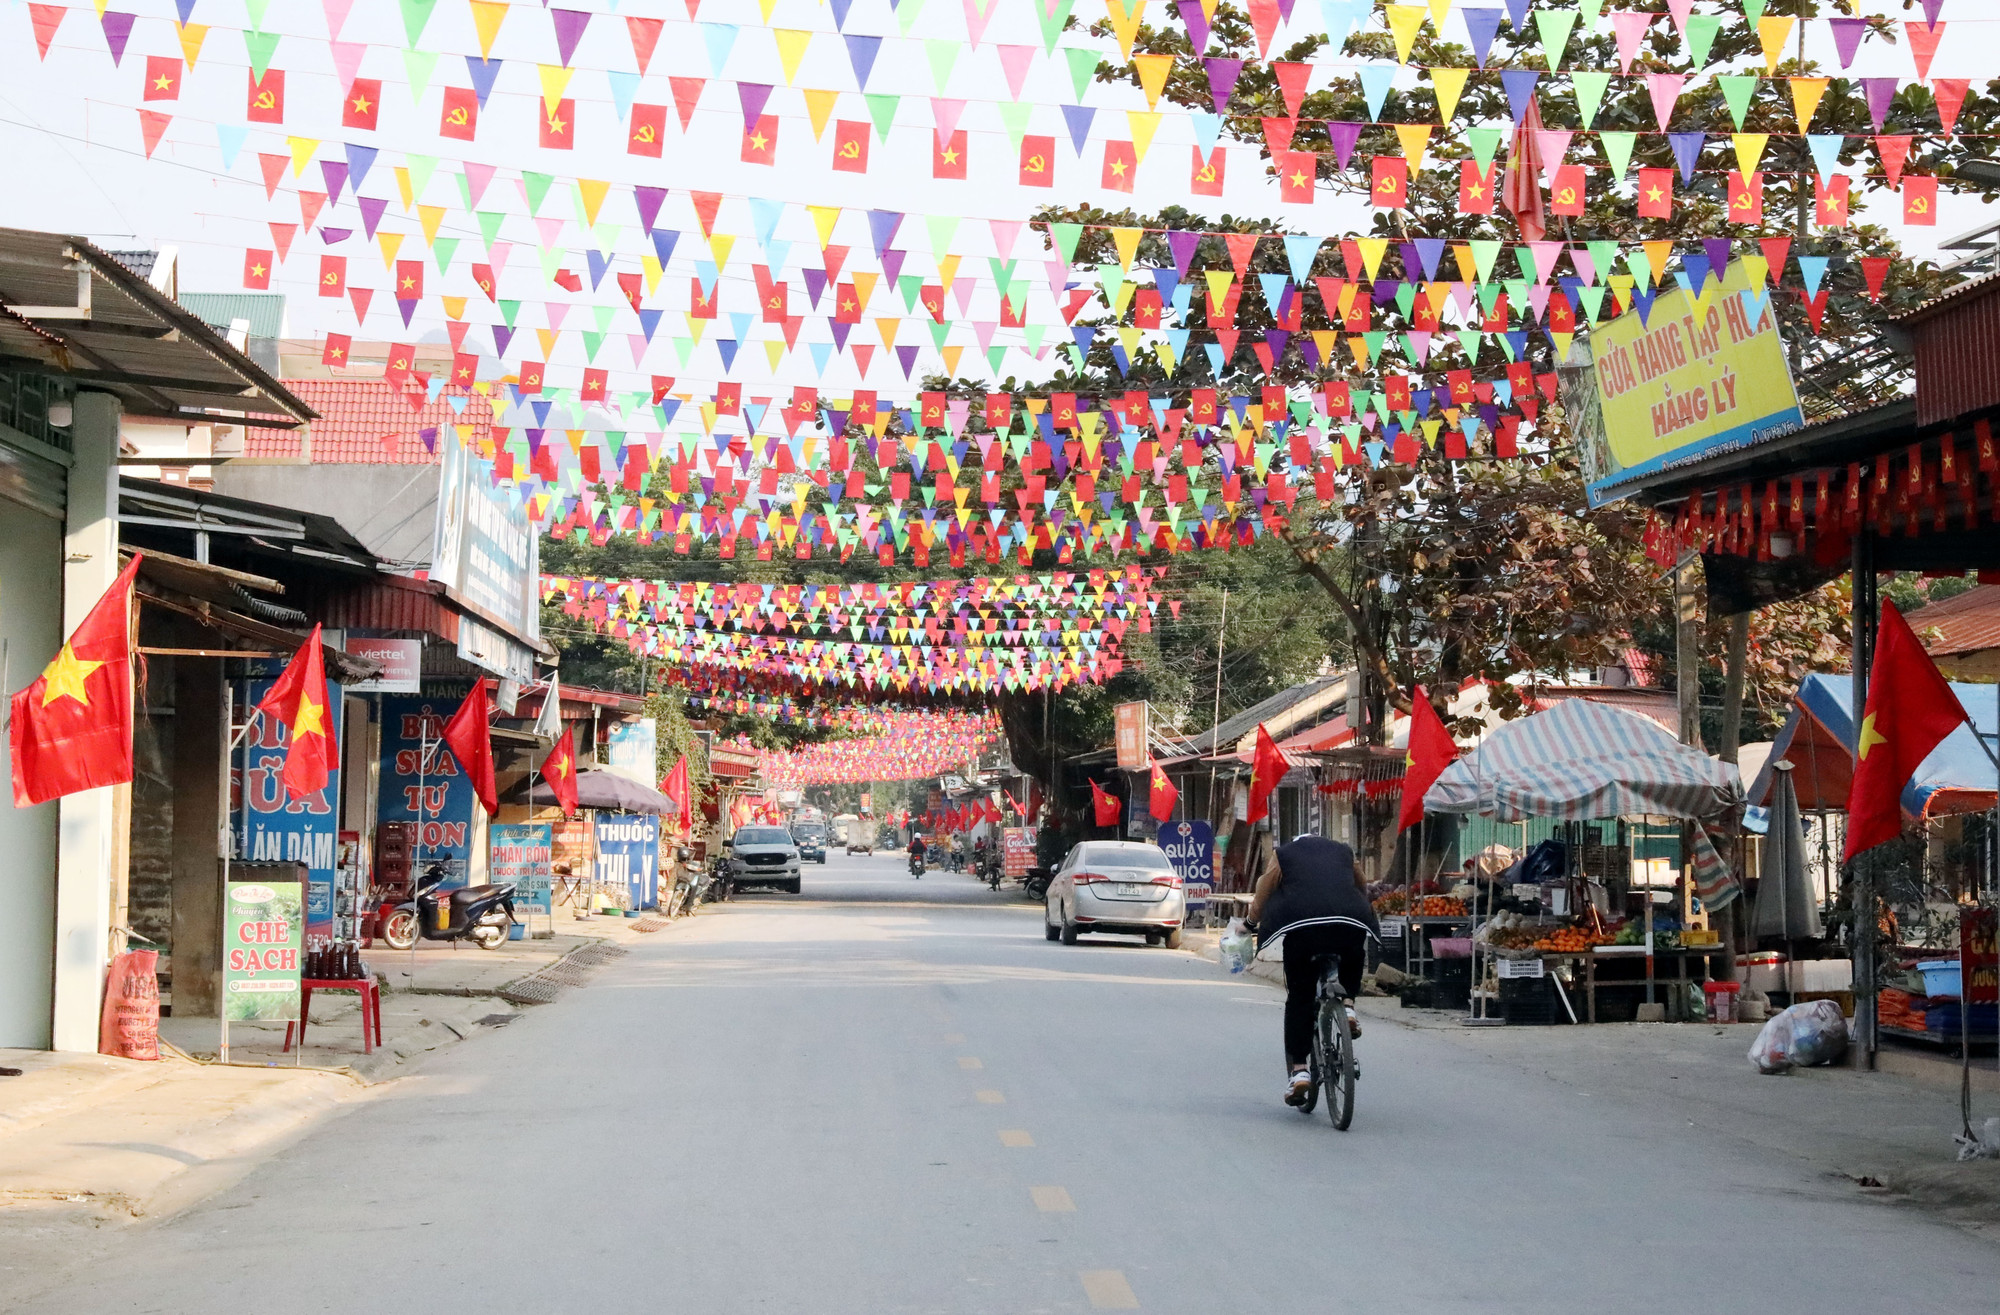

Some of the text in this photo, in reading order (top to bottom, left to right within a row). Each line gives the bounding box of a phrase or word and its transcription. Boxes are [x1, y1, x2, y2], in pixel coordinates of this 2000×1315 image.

[1598, 338, 1637, 400] CỬA
[1632, 322, 1688, 384] HÀNG
[1683, 304, 1721, 366] TẠP
[1651, 365, 1737, 438] HẰNG LÝ
[360, 648, 405, 659] viettel
[404, 781, 449, 818] TỰ
[253, 823, 281, 861] ĂN
[599, 818, 654, 842] THUỐC
[492, 843, 522, 864] PHÂN
[1165, 836, 1206, 859] QUẦY
[598, 845, 630, 885] THÚ
[641, 854, 653, 904] Y
[238, 915, 290, 944] CHÈ
[229, 948, 298, 977] SẠCH
